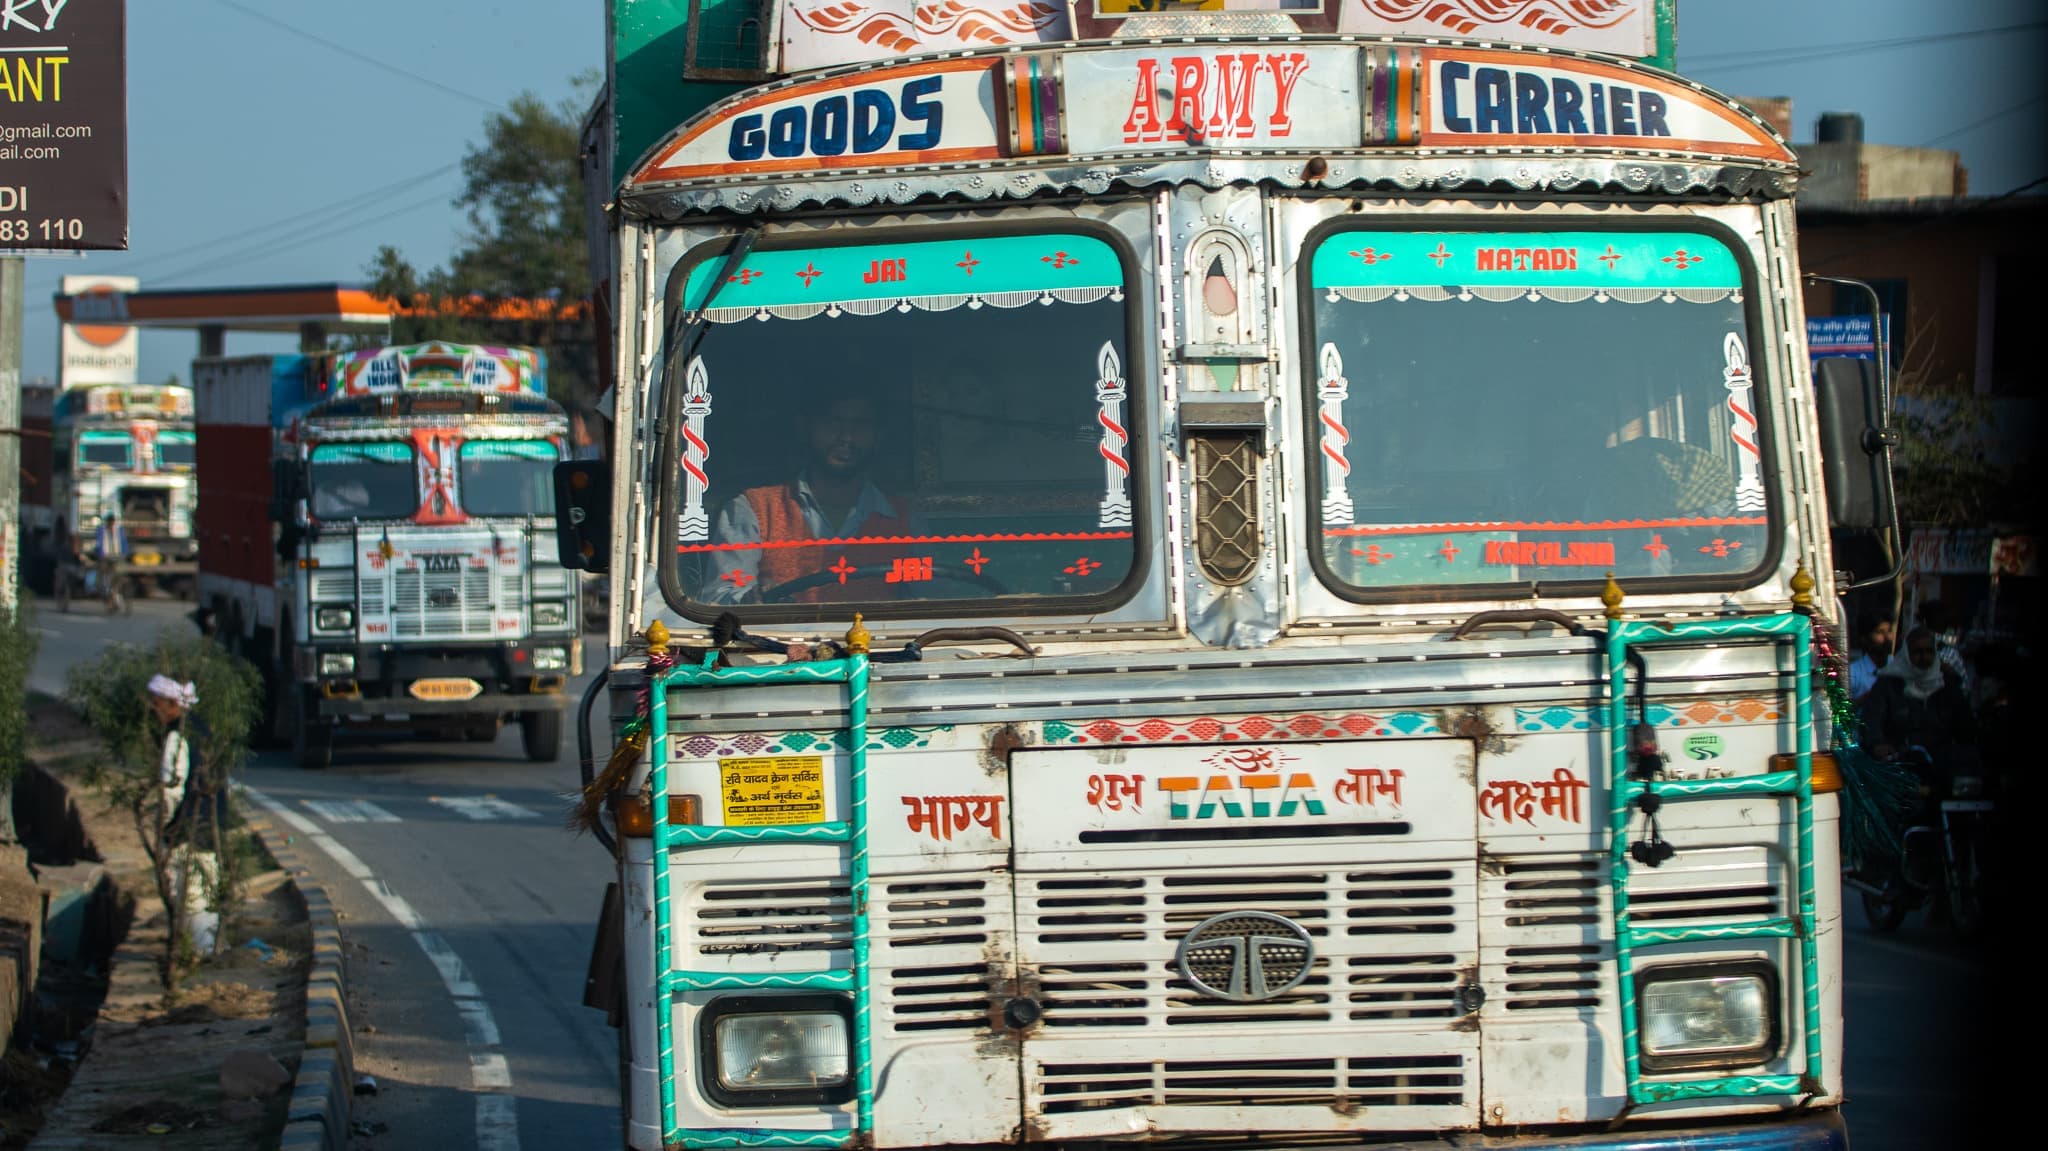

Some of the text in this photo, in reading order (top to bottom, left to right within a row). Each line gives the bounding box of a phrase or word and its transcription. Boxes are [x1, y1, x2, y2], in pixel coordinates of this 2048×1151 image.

[728, 53, 1671, 161] GOODS ARMY CARRIER
[0, 123, 92, 142] gmail.com
[0, 218, 84, 241] 83 110
[863, 258, 906, 284] JAI
[1477, 248, 1577, 271] MATADI
[423, 554, 461, 571] TATA
[885, 556, 933, 583] JAI
[726, 772, 741, 784] रवि
[744, 774, 768, 784] यादव
[1158, 773, 1328, 820] TATA
[1479, 767, 1591, 827] लक्ष्मी
[901, 795, 1005, 842] भाग्य
